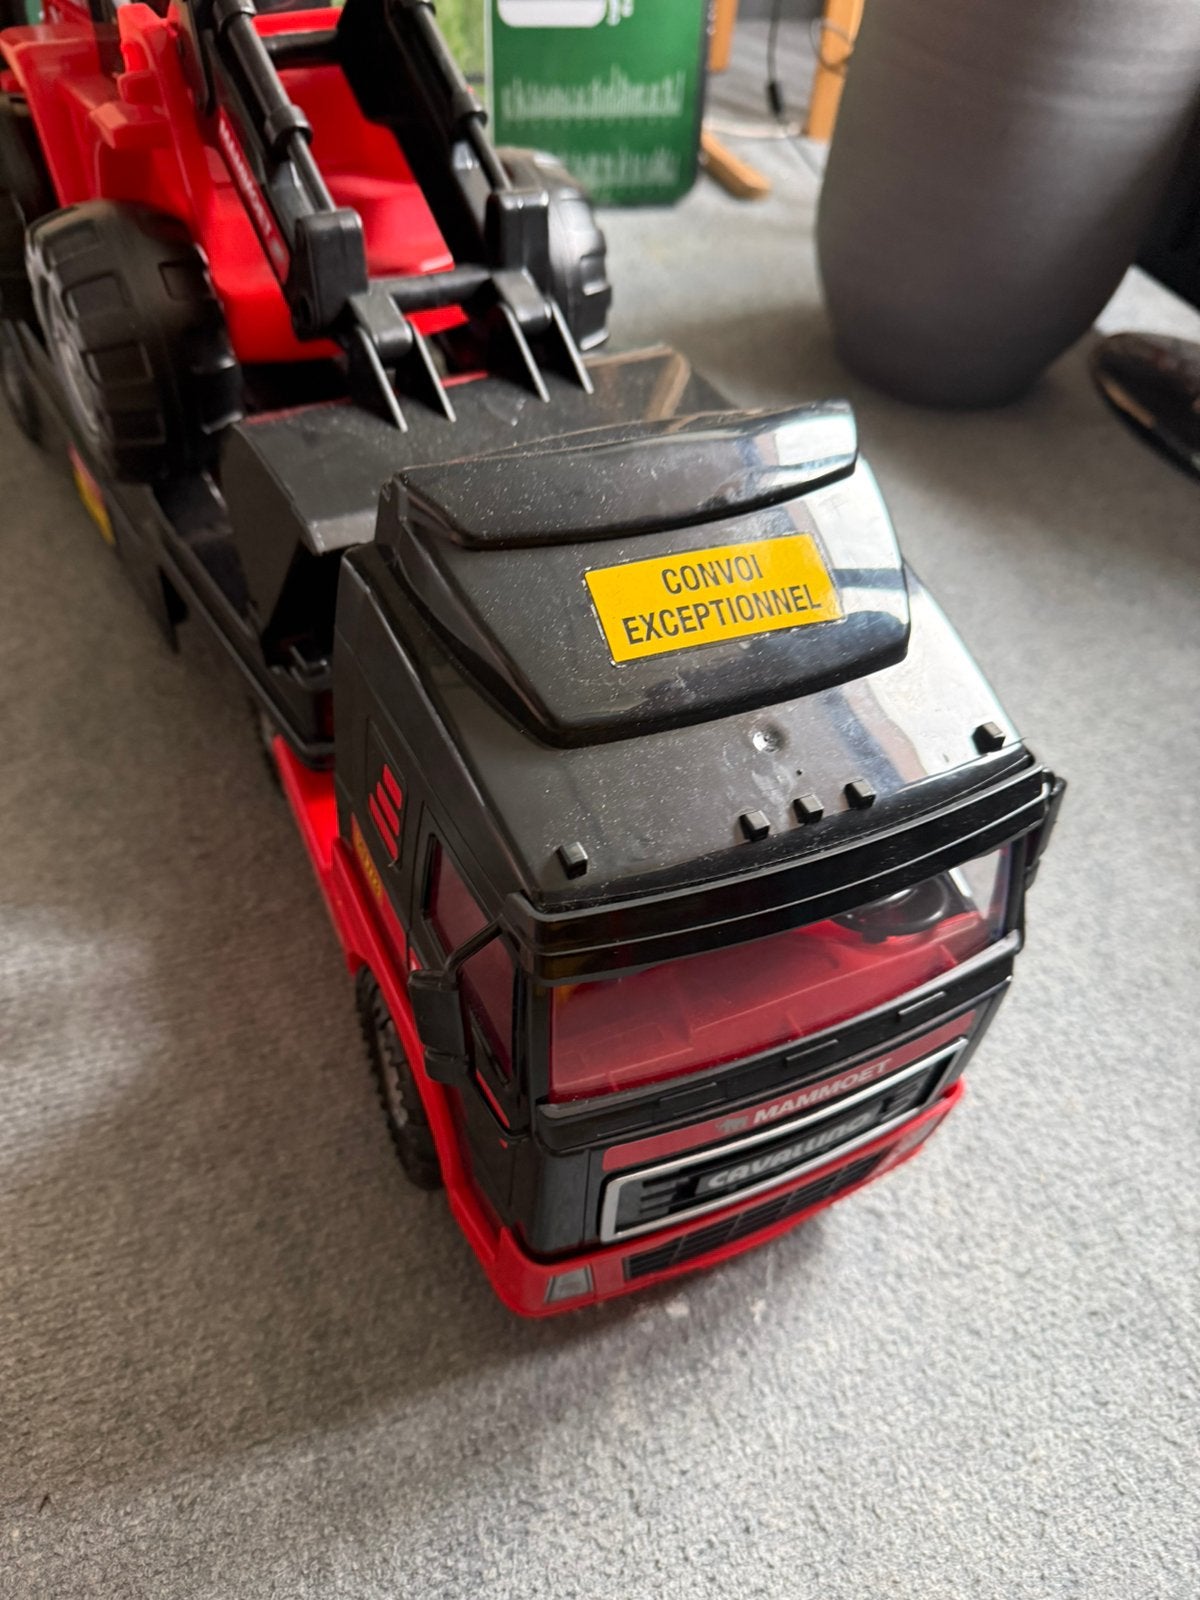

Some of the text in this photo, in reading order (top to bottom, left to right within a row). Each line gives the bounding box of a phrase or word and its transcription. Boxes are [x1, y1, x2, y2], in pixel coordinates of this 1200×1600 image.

[661, 554, 764, 595] CONVOI
[621, 584, 822, 645] EXCEPTIONNEL
[753, 1058, 892, 1124] MAMMOET
